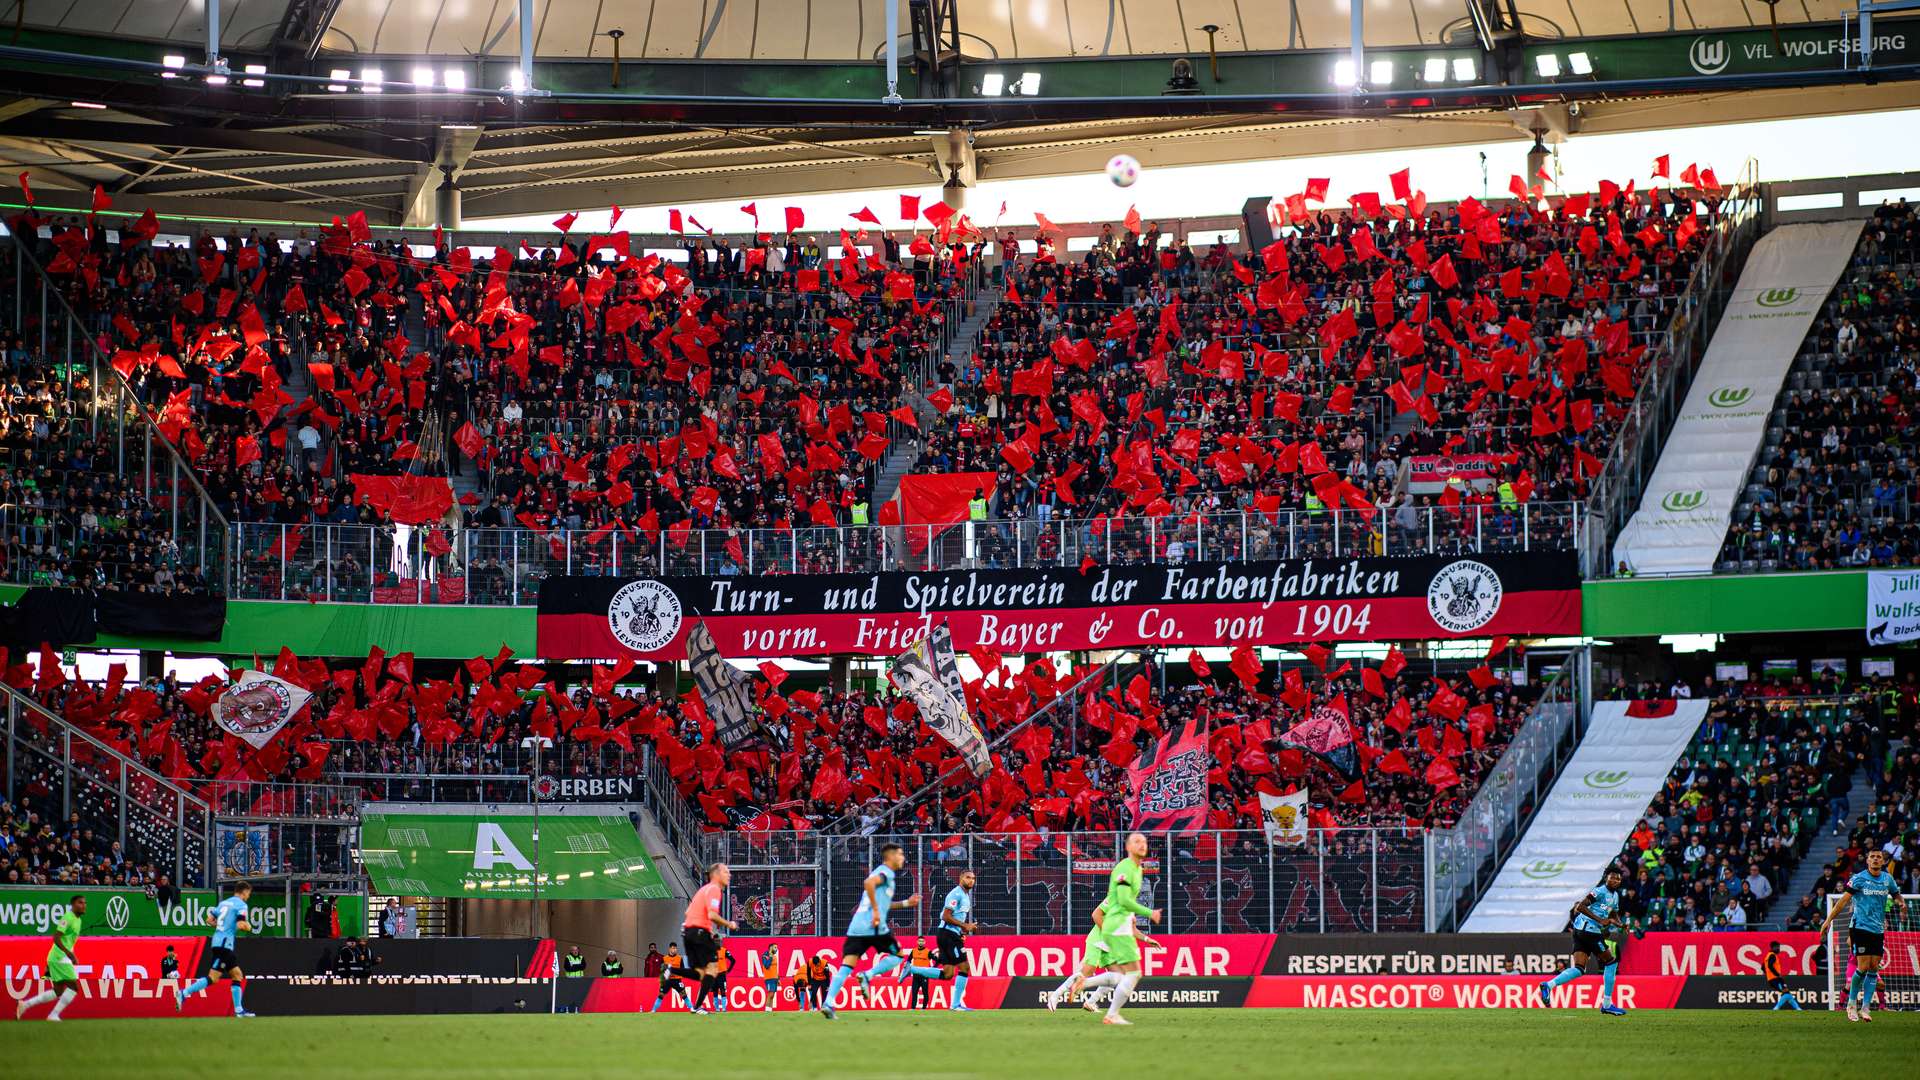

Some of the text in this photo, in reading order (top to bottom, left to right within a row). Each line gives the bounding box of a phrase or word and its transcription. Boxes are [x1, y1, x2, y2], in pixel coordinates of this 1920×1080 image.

[1744, 44, 1773, 60] VfL
[1411, 462, 1434, 473] LEV
[710, 560, 1400, 619] Turn- und Spielverein der Farbenfabriken
[742, 603, 1371, 652] vorm. Fried Bayer & Co. von 1904
[1434, 611, 1494, 631] LEVERKUSEN
[615, 629, 674, 650] LEVERKUSEN
[63, 650, 76, 662] 29
[561, 777, 632, 796] ERBEN
[473, 823, 536, 870] A
[157, 898, 287, 935] Volksgen
[217, 906, 229, 931] 2
[966, 947, 1231, 976] WOREAR
[1288, 954, 1385, 973] RESPEKT
[1392, 951, 1434, 973] FÜR
[1441, 954, 1505, 973] DEINE
[1130, 990, 1169, 1003] DEINE
[1172, 990, 1220, 1003] ARBEIT
[1303, 984, 1445, 1008] MASCOT®
